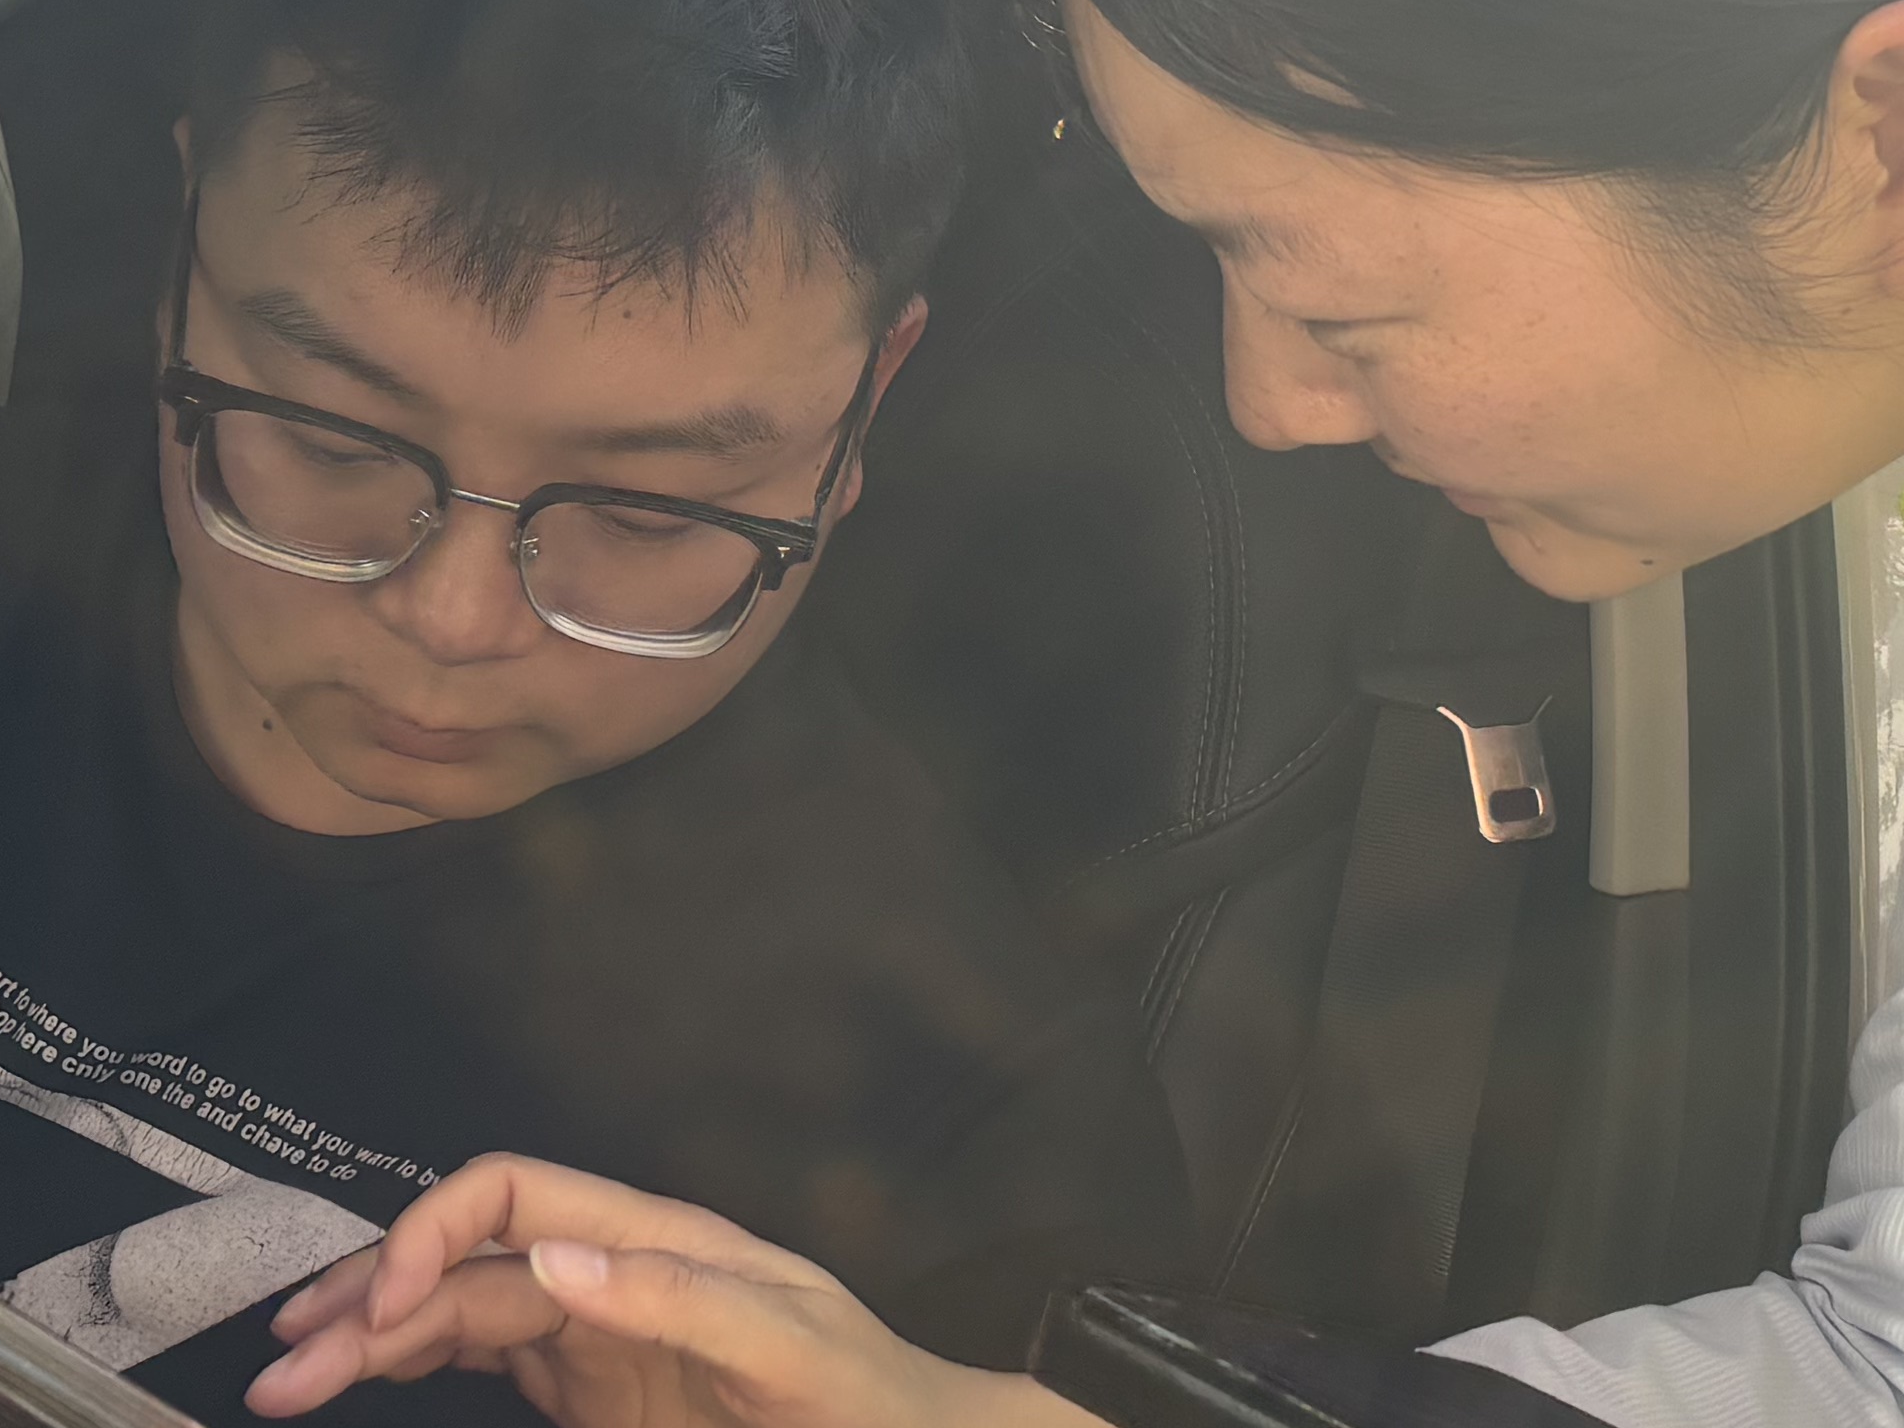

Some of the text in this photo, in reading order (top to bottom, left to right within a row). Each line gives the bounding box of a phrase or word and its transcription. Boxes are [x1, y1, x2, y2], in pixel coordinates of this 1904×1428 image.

[76, 1037, 125, 1065] you
[186, 1062, 207, 1085] to
[205, 1076, 236, 1099] go
[238, 1088, 261, 1112] to
[263, 1102, 317, 1141] what
[311, 1130, 355, 1157] you
[119, 1069, 162, 1094] one
[162, 1082, 195, 1110] the
[196, 1101, 243, 1132] and
[306, 1153, 330, 1173] to
[329, 1163, 358, 1181] do
